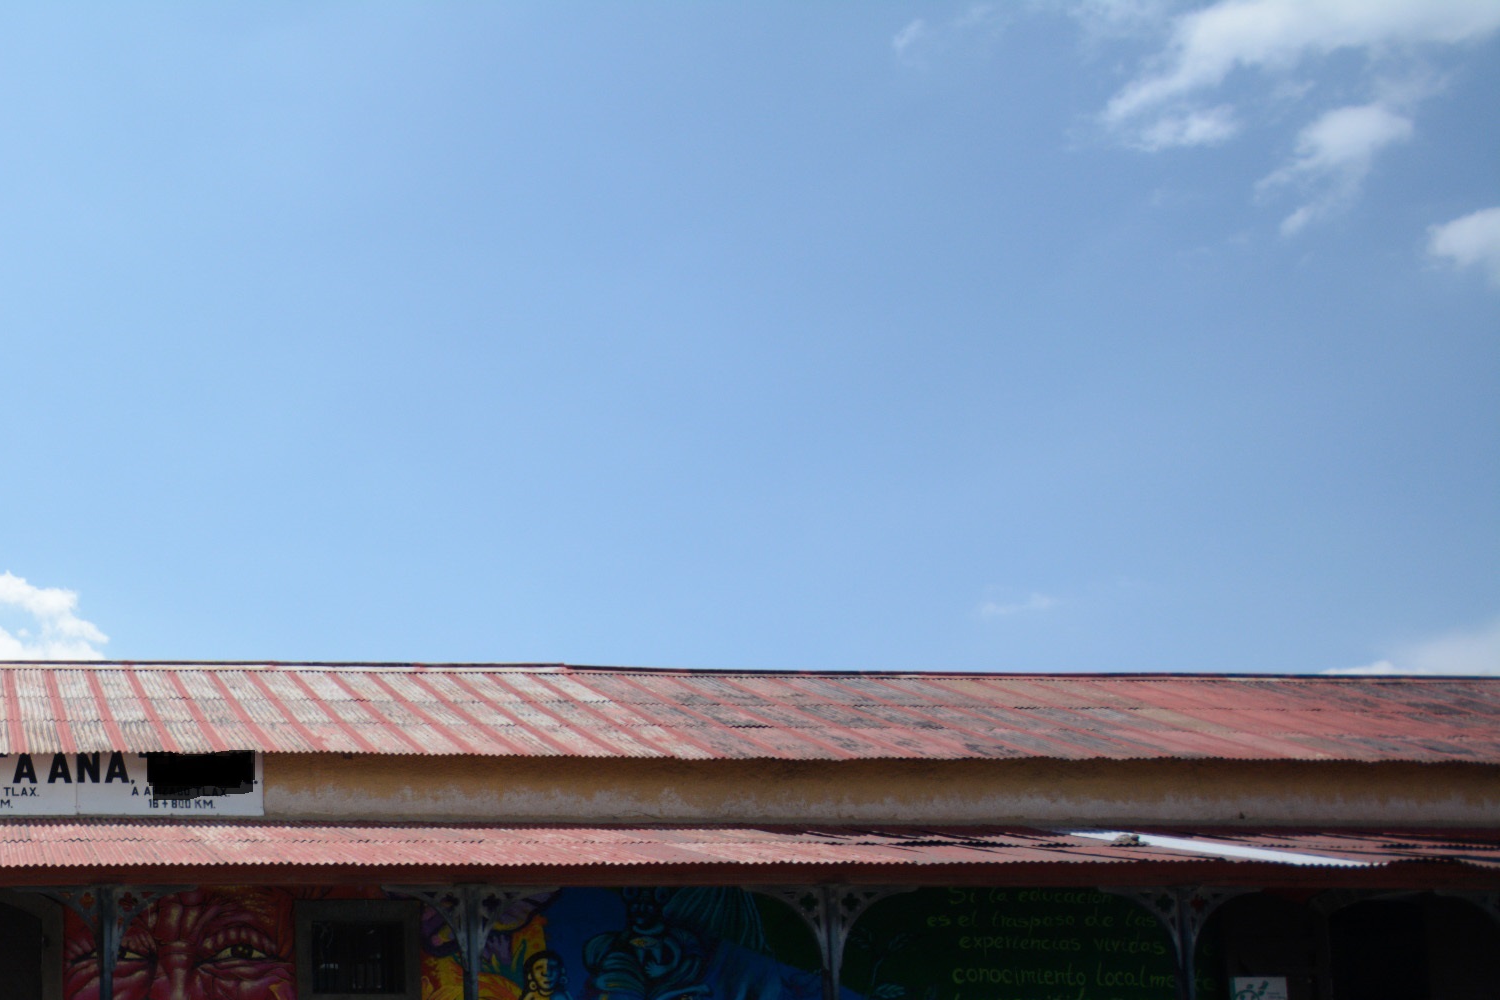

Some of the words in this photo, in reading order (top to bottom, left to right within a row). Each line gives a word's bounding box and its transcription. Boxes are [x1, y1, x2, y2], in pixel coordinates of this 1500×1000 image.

[47, 752, 135, 785] ANA,
[4, 787, 39, 797] TLAX.
[131, 786, 139, 796] A
[149, 799, 158, 809] 16
[171, 799, 190, 809] 800
[195, 799, 216, 809] KM.
[947, 887, 976, 905] Si
[926, 914, 951, 928] es
[957, 910, 978, 928] el
[992, 910, 1075, 933] traspaso
[1084, 908, 1114, 928] de
[1125, 911, 1157, 929] las
[959, 935, 1081, 958] experiencias
[1094, 932, 1166, 956] vividas
[952, 962, 1086, 986] conocimiento
[1096, 961, 1219, 992] localmete
